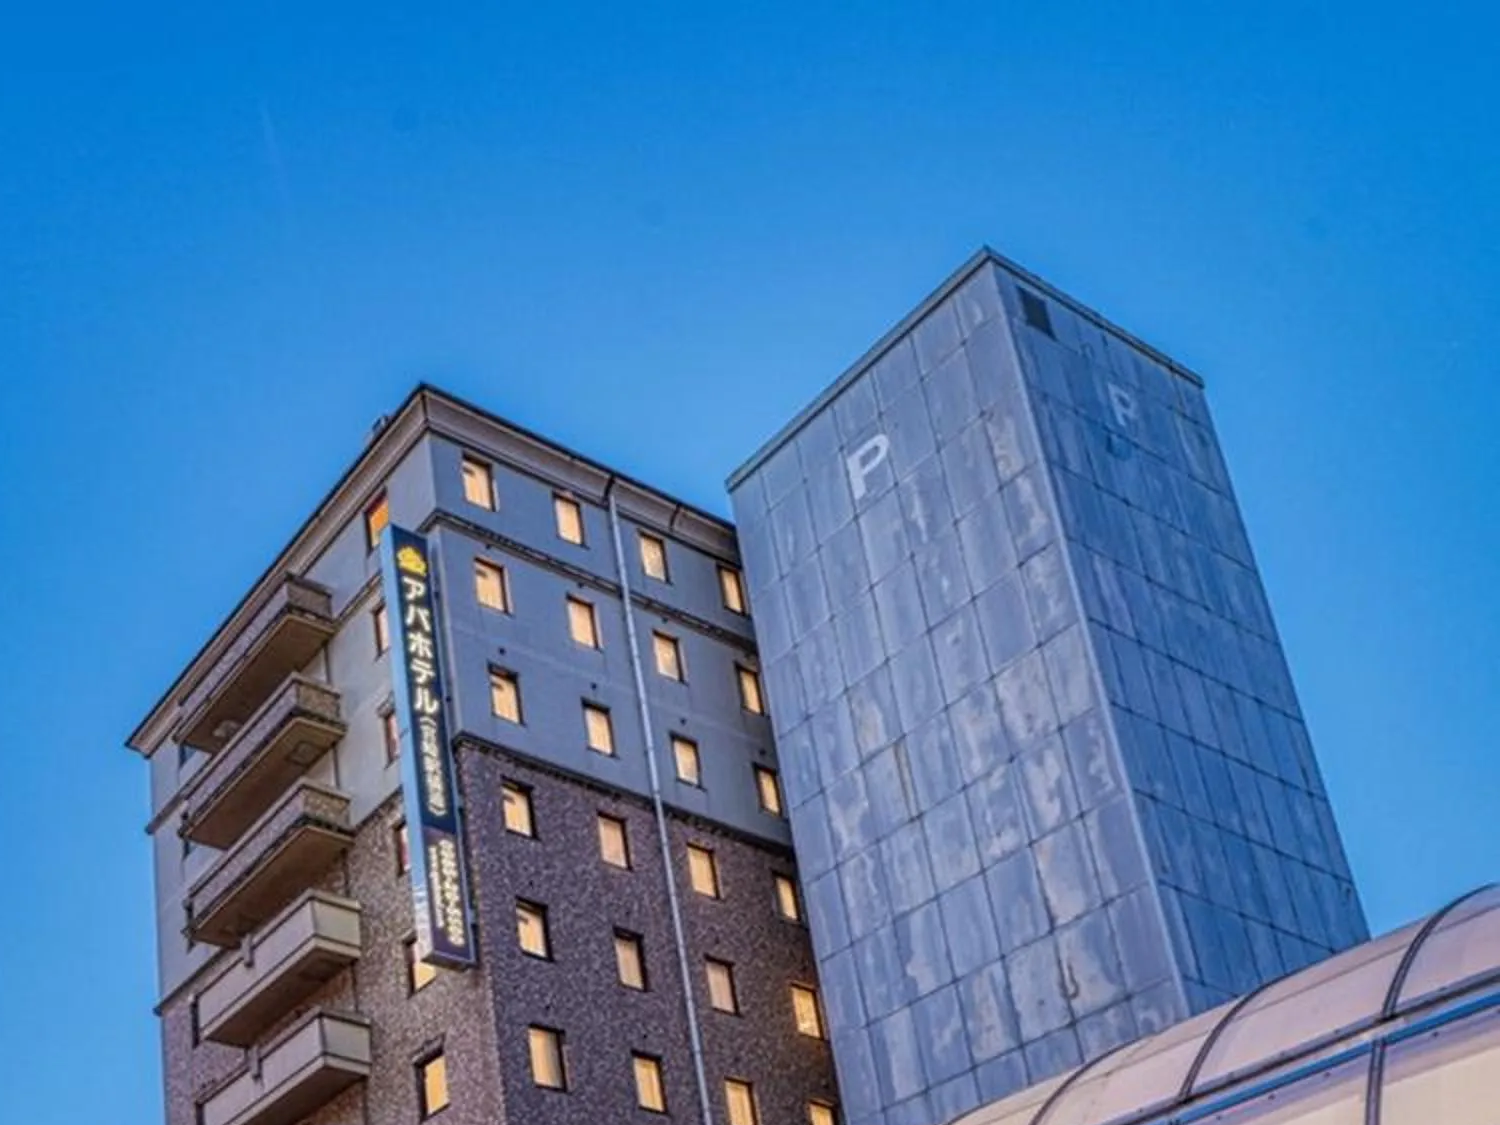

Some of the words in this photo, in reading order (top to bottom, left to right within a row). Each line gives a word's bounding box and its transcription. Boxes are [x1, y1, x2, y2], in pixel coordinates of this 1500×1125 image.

[846, 433, 890, 501] P
[402, 574, 439, 714] アパホテル
